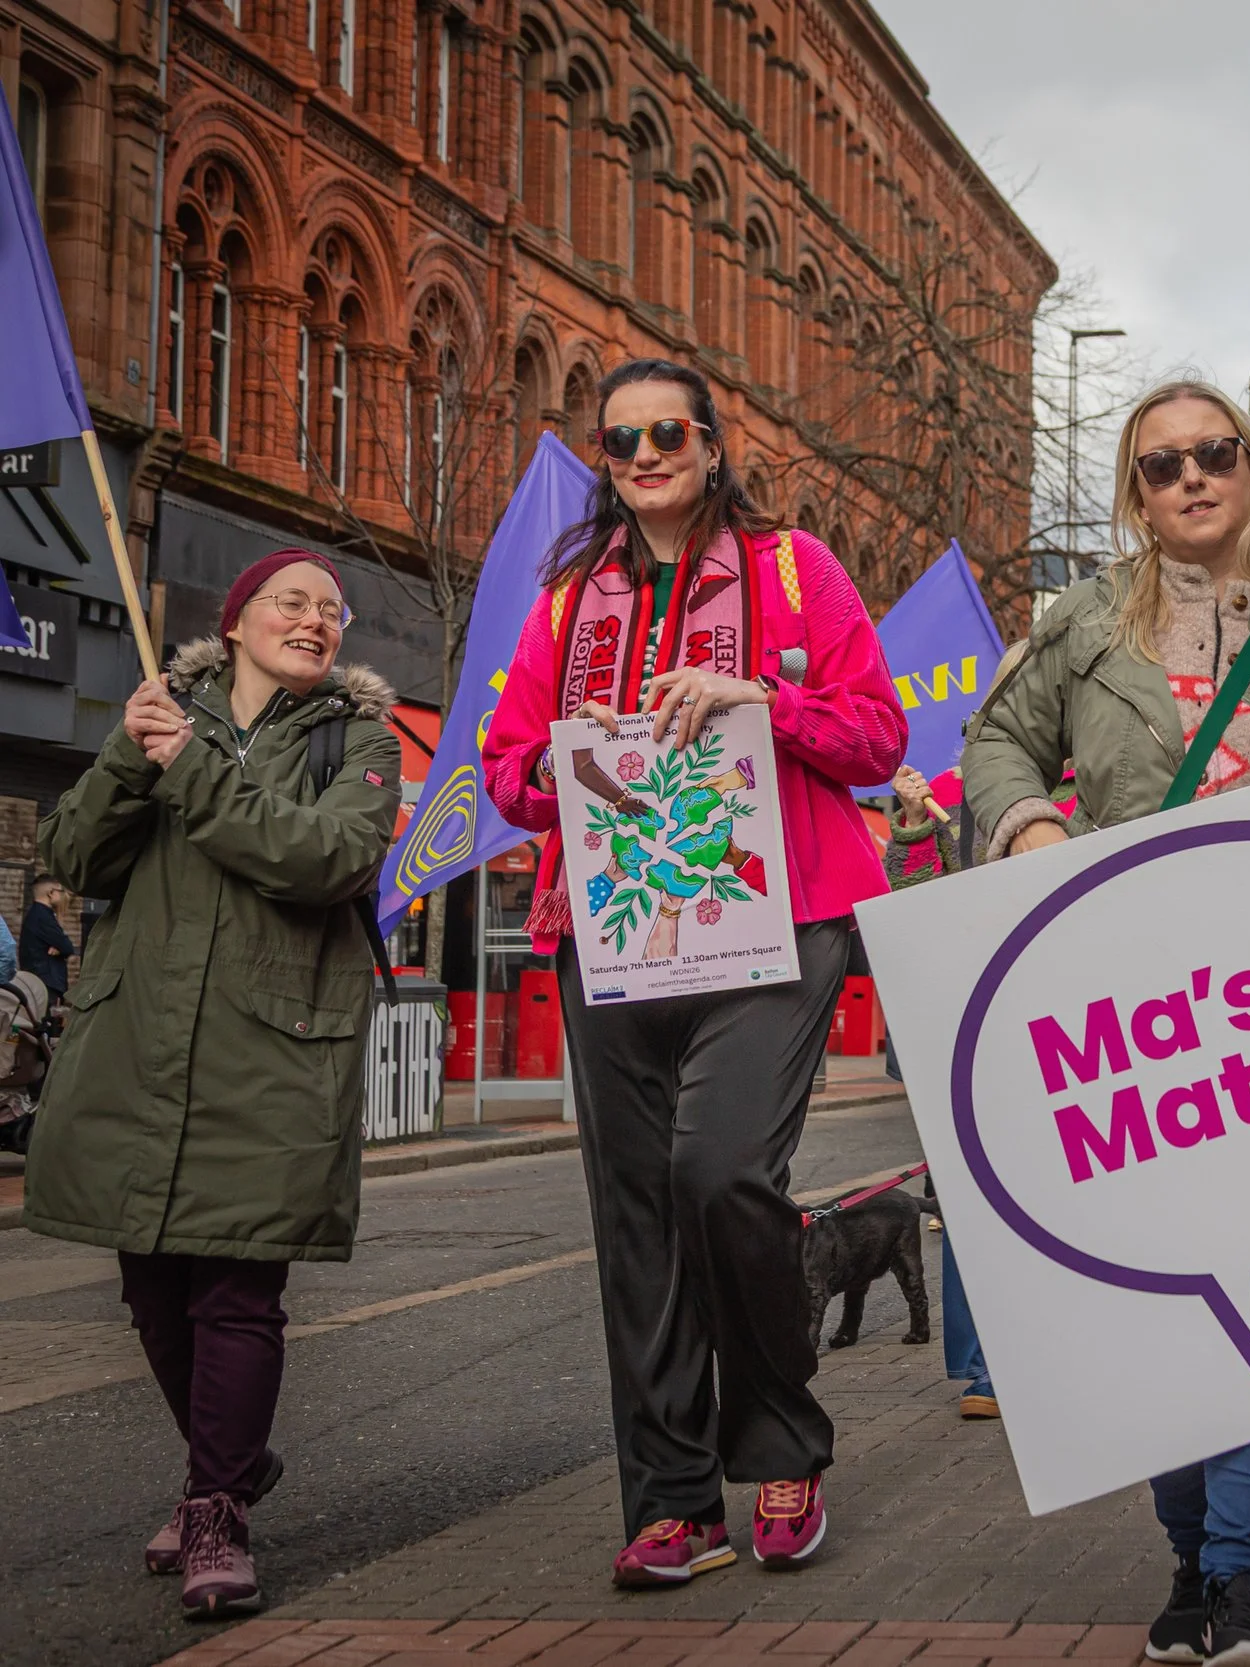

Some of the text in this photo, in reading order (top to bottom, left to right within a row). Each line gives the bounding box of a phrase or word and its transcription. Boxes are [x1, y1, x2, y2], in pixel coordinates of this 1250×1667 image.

[1, 453, 34, 474] ar
[16, 615, 56, 660] ar
[715, 625, 737, 678] MEN
[565, 621, 595, 712] UATION
[583, 615, 622, 706] TERS
[587, 716, 645, 730] Intetional
[707, 709, 730, 719] 2026
[604, 729, 651, 742] Strength
[589, 944, 782, 975] Saturday 7th March 11.30am Writers Square
[648, 973, 727, 989] reclaimtheagenda.com
